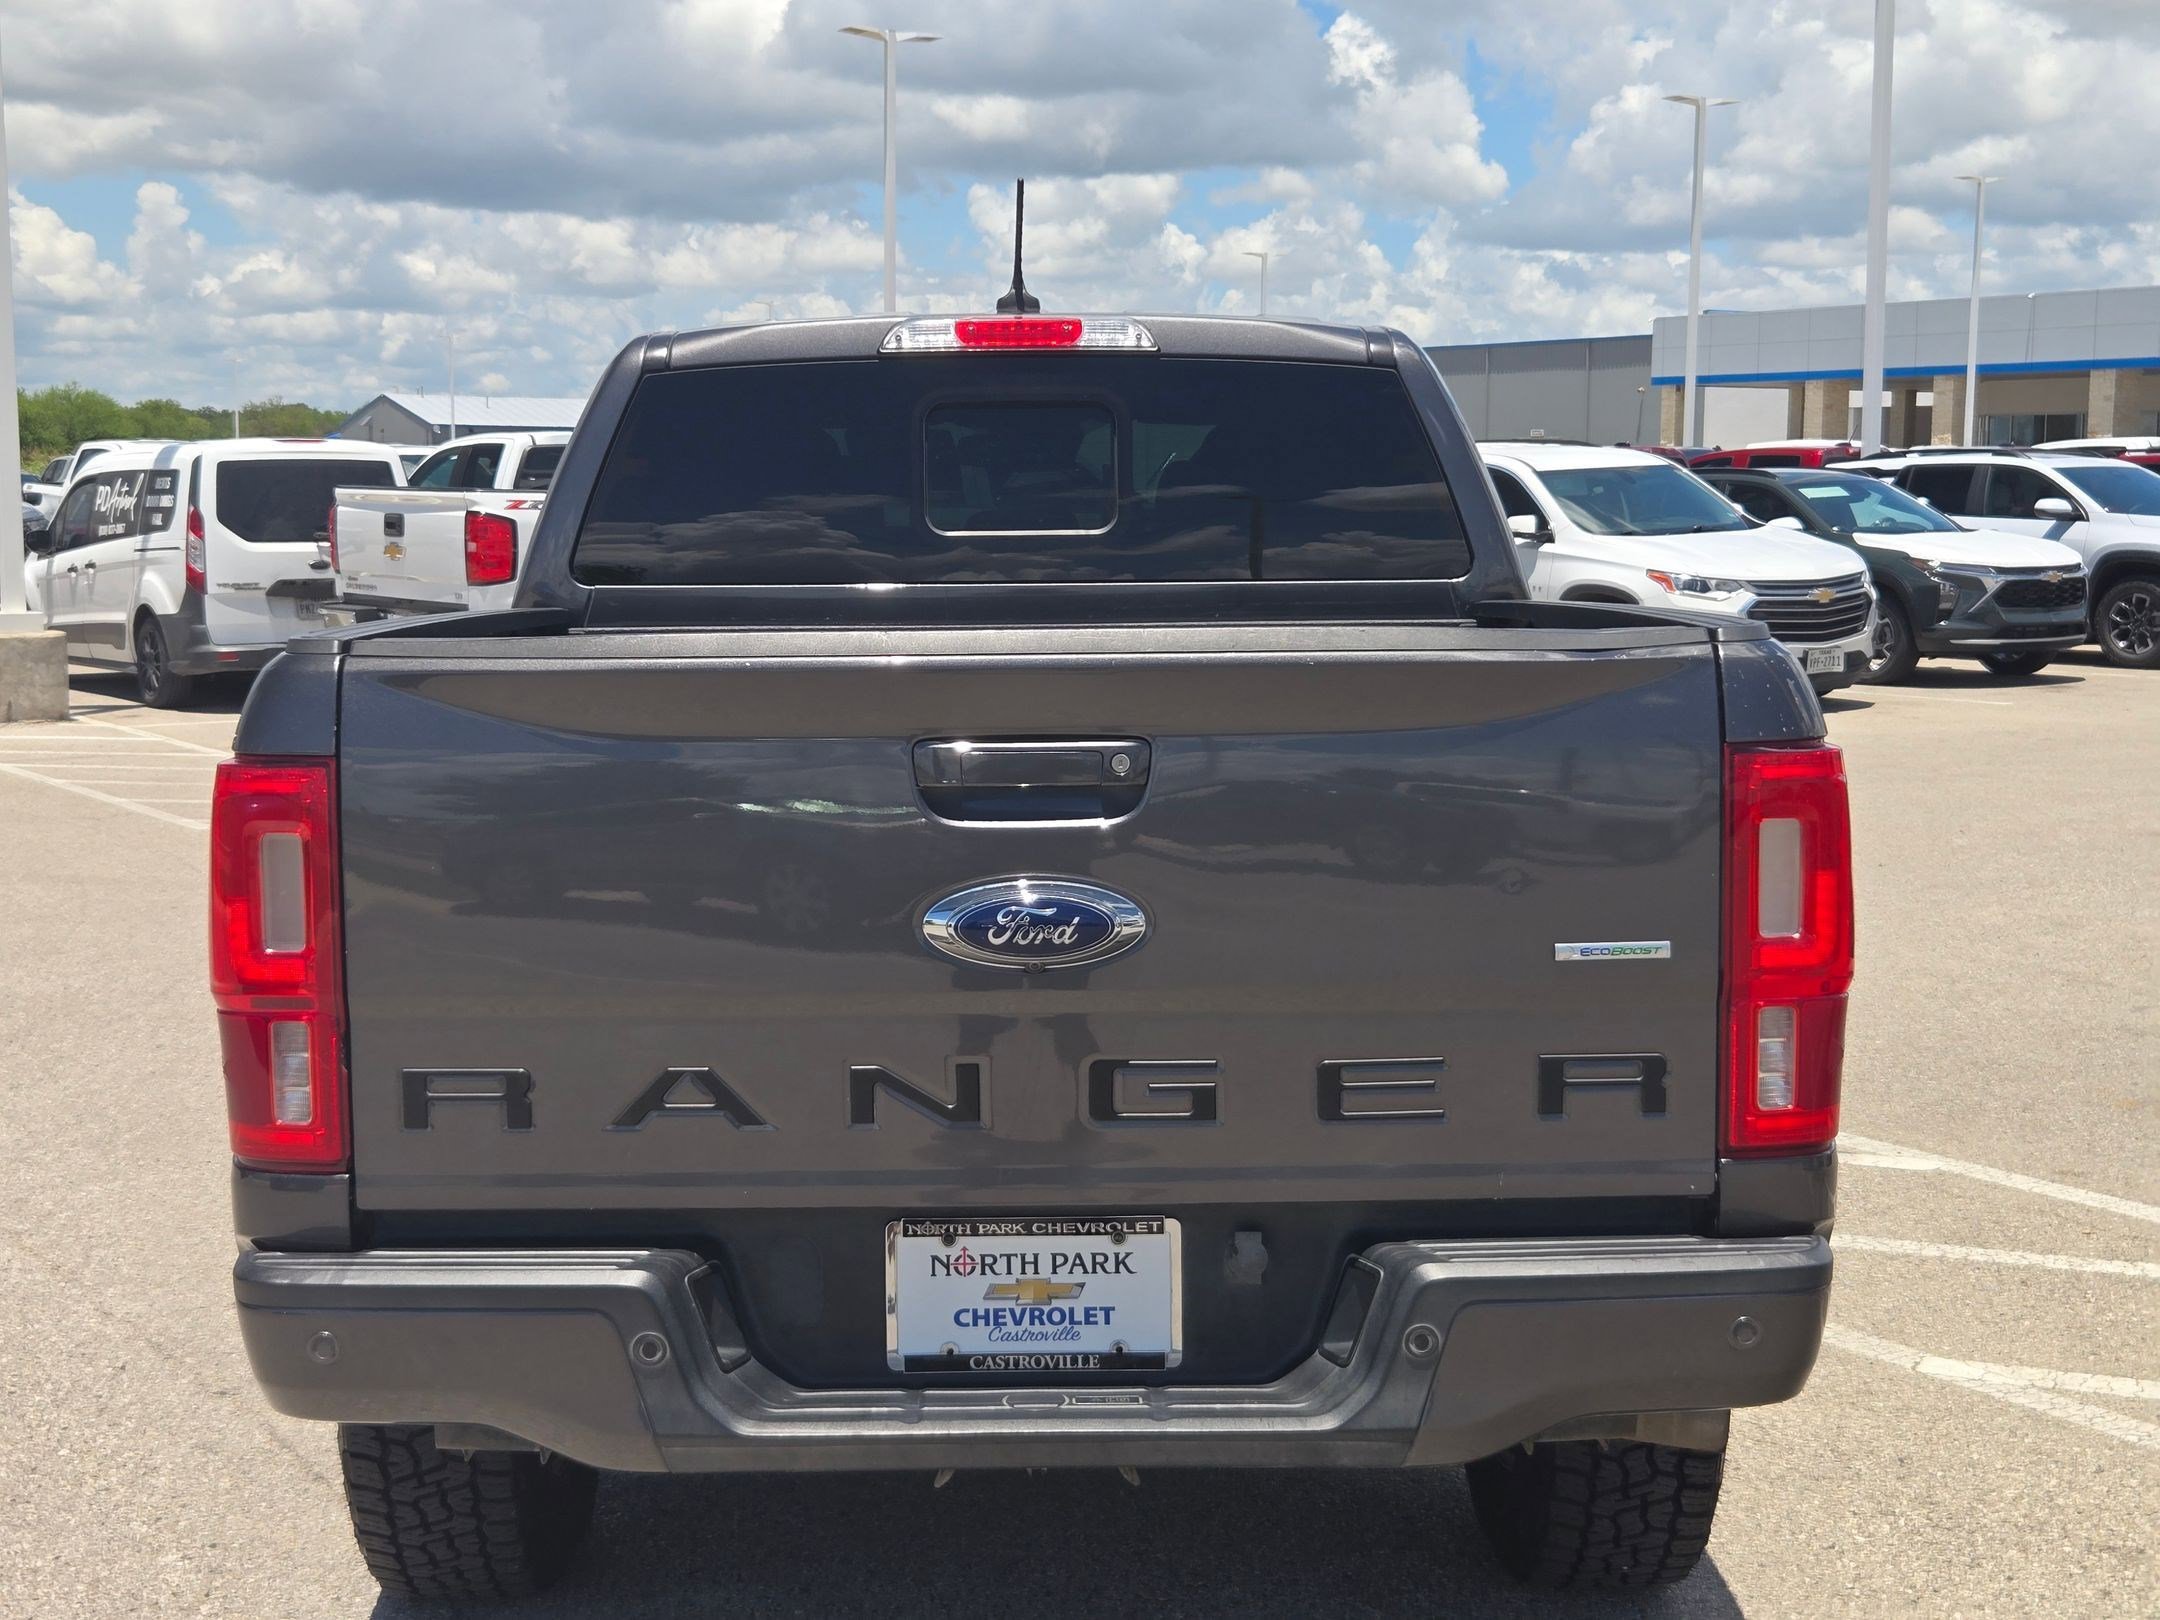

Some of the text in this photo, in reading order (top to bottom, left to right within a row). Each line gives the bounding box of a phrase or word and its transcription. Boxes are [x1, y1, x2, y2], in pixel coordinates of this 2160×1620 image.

[987, 905, 1081, 946] Ford
[1580, 946, 1662, 957] ECOBOOST
[401, 1052, 1669, 1132] RANGER
[905, 1221, 1162, 1236] NORTH PARK CHEVROLET
[930, 1250, 1137, 1277] NORTH PARK
[954, 1306, 1116, 1327] CHEVROLET
[988, 1326, 1082, 1342] Castroville
[969, 1354, 1101, 1370] CASTROVILLE
